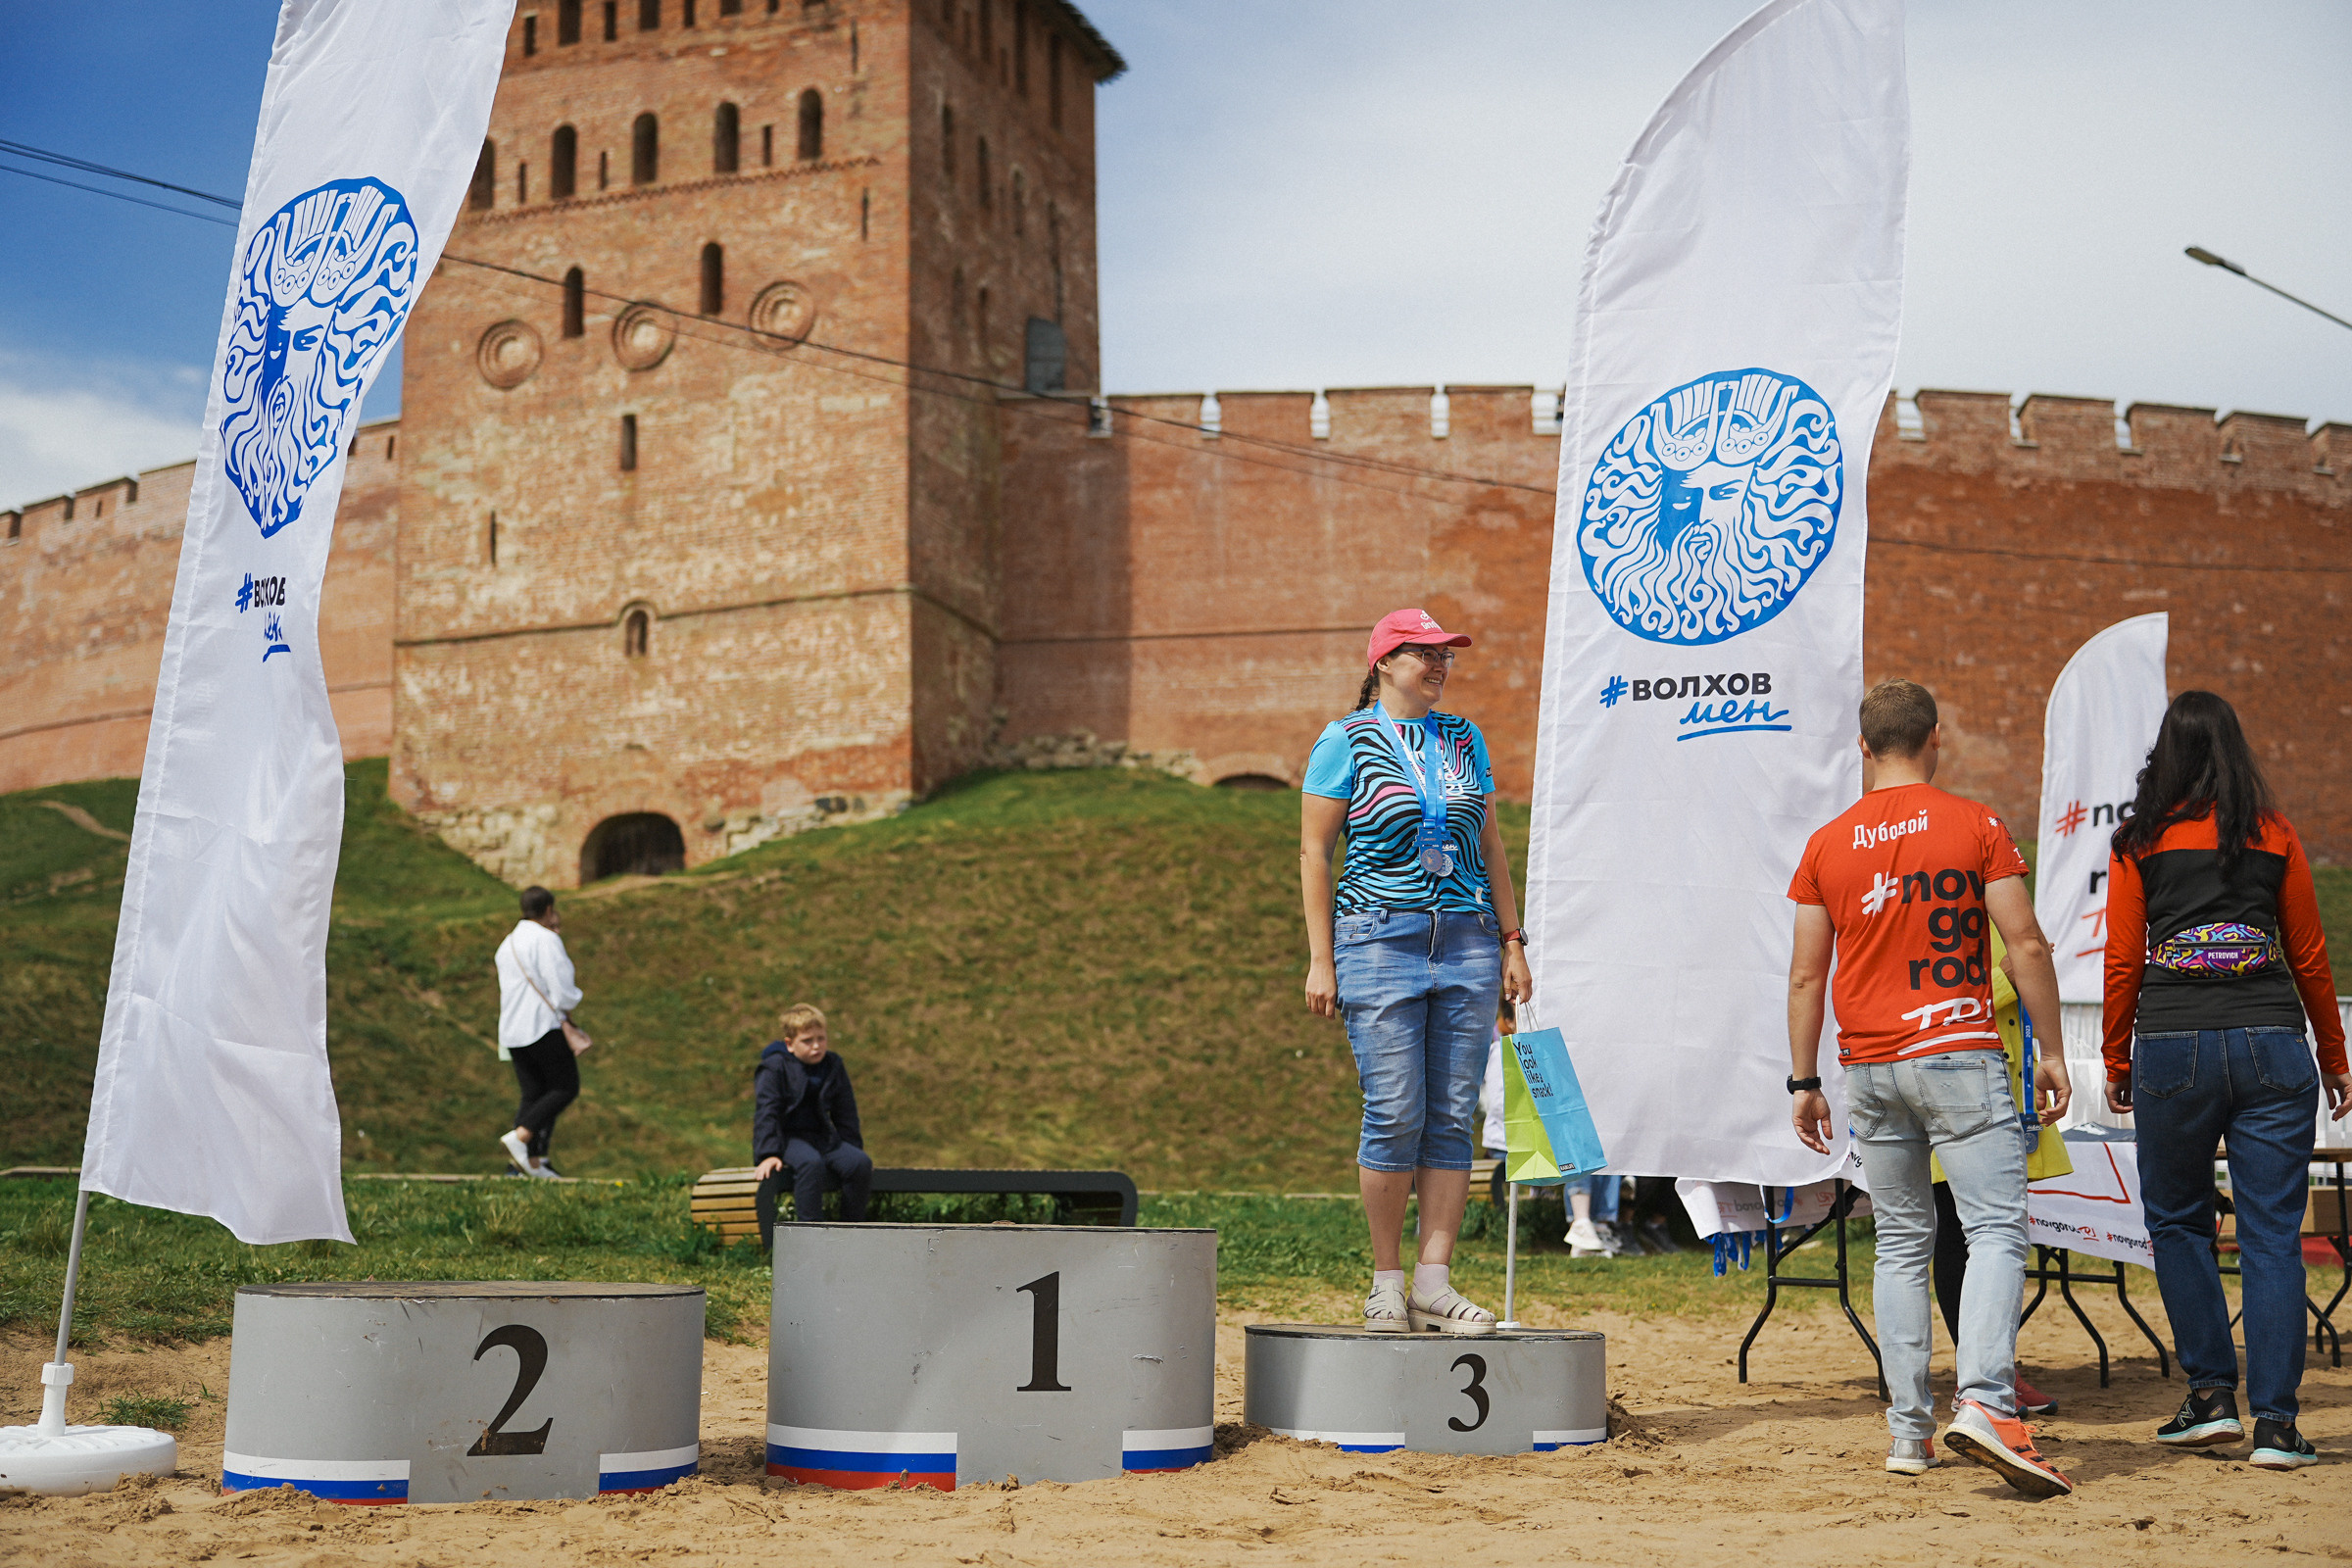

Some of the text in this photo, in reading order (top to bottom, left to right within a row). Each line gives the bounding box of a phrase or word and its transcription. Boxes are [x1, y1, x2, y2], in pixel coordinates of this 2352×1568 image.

[1599, 673, 1773, 708] #ВОЛХОВ
[1679, 700, 1790, 727] мен
[1852, 809, 1929, 850] Дубовой
[1928, 906, 1984, 954] go
[1908, 938, 1987, 990] rod
[2207, 951, 2239, 960] PETROVICH
[1513, 1041, 1534, 1055] You
[1519, 1054, 1539, 1070] look
[1525, 1070, 1540, 1084] like
[1532, 1082, 1554, 1099] snack!
[1016, 1271, 1071, 1392] 1
[466, 1324, 554, 1456] 2
[1447, 1353, 1491, 1432] 3
